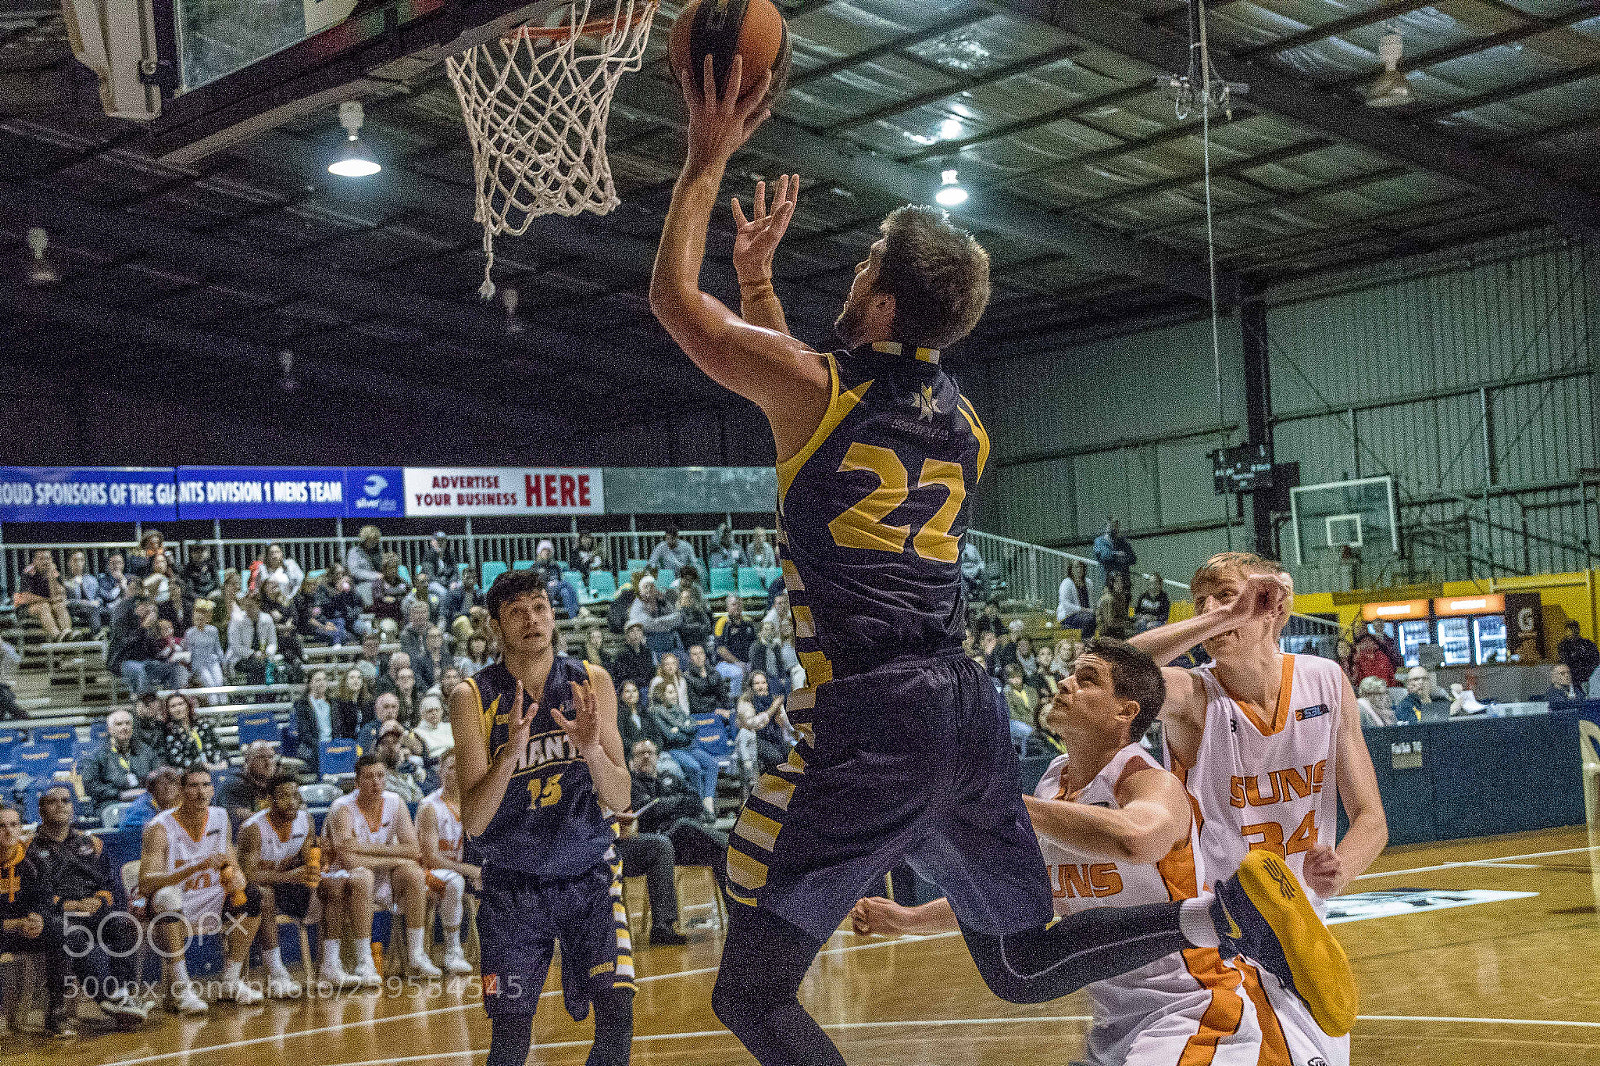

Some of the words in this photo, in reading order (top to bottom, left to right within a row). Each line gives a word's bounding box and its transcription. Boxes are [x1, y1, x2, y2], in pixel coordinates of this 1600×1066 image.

[0, 482, 33, 505] OUD
[35, 482, 107, 505] SPONSORS
[109, 482, 127, 504] OF
[129, 483, 154, 504] THE
[155, 481, 204, 504] GIANTS
[206, 481, 262, 503] DIVISION
[264, 481, 272, 502] 1
[273, 481, 308, 503] MENS
[309, 481, 343, 502] TEAM
[415, 494, 451, 506] YOUR
[457, 493, 517, 506] BUSINESS
[432, 476, 500, 489] ADVERTISE
[525, 474, 591, 507] HERE
[827, 441, 967, 564] 22
[527, 773, 564, 810] 15
[1230, 759, 1328, 808] SUNS
[1047, 862, 1123, 898] UNS
